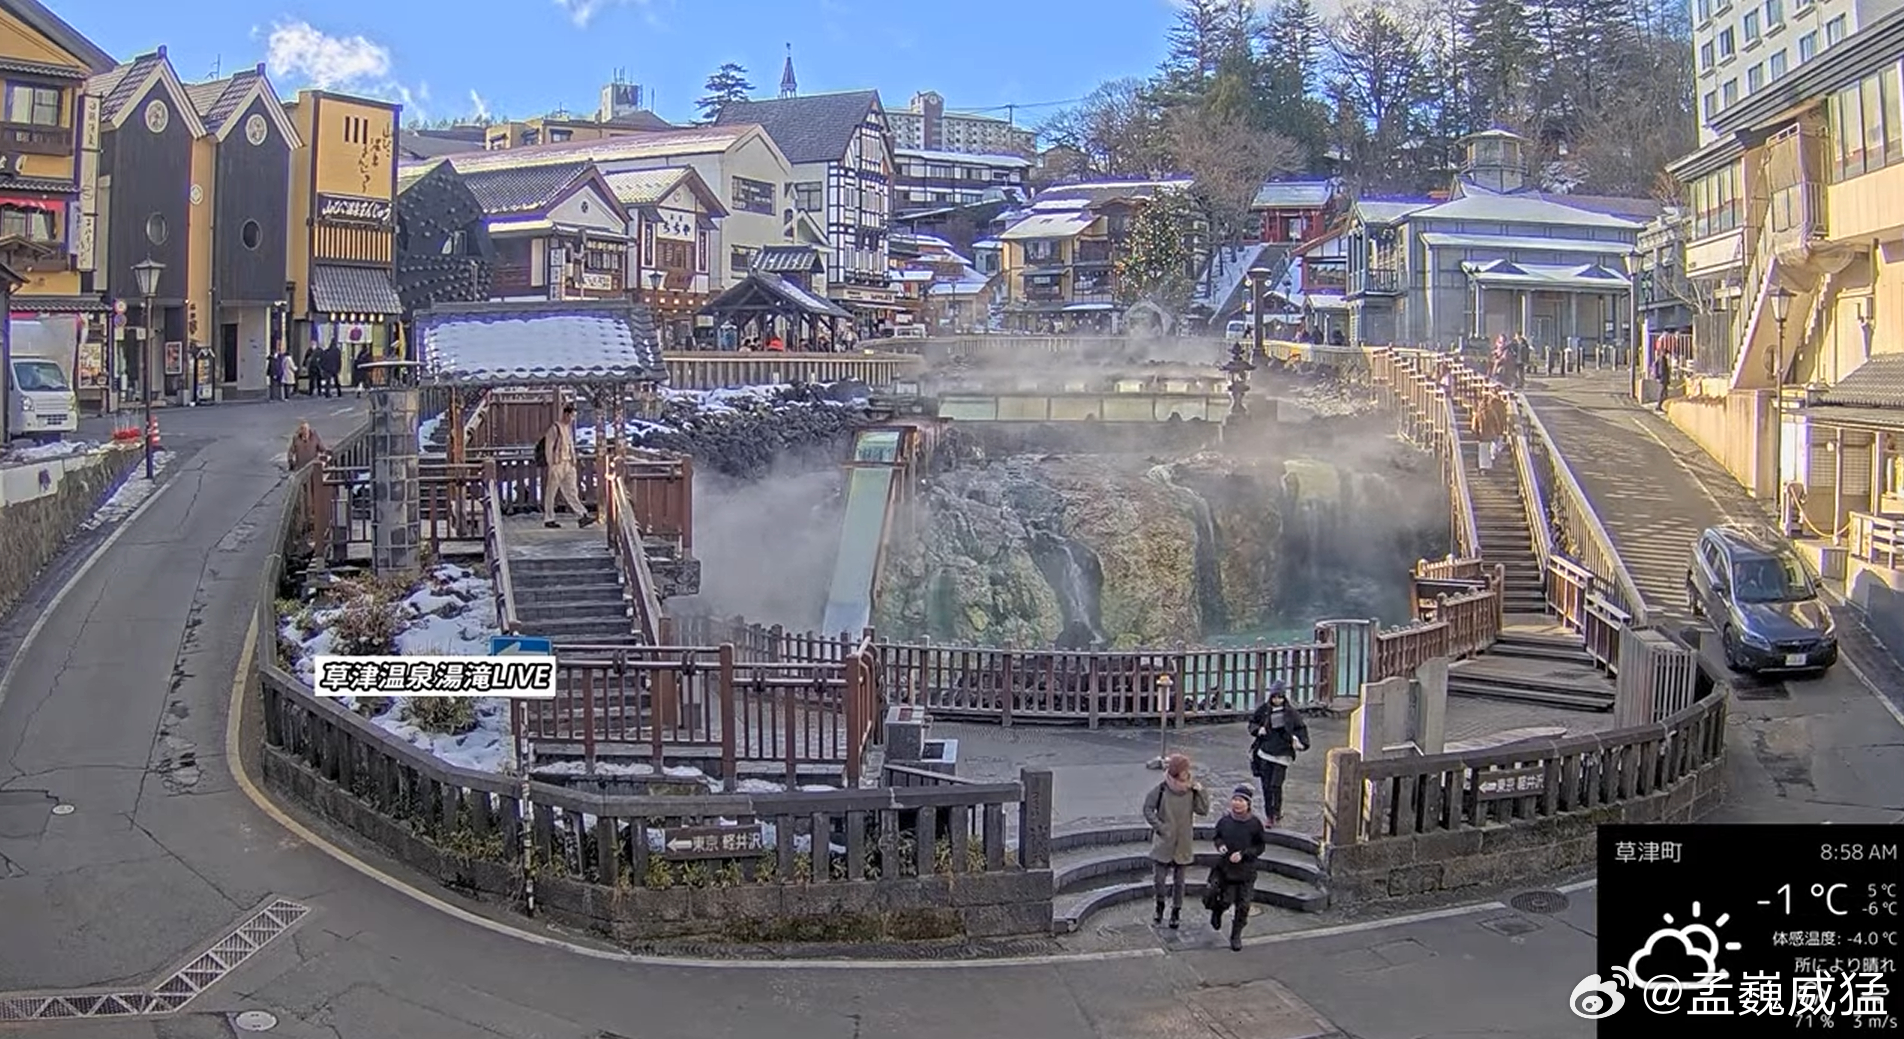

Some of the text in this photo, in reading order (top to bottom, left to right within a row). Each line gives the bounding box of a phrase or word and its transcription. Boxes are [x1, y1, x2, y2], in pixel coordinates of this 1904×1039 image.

[692, 832, 762, 853] 東京 軽井沢
